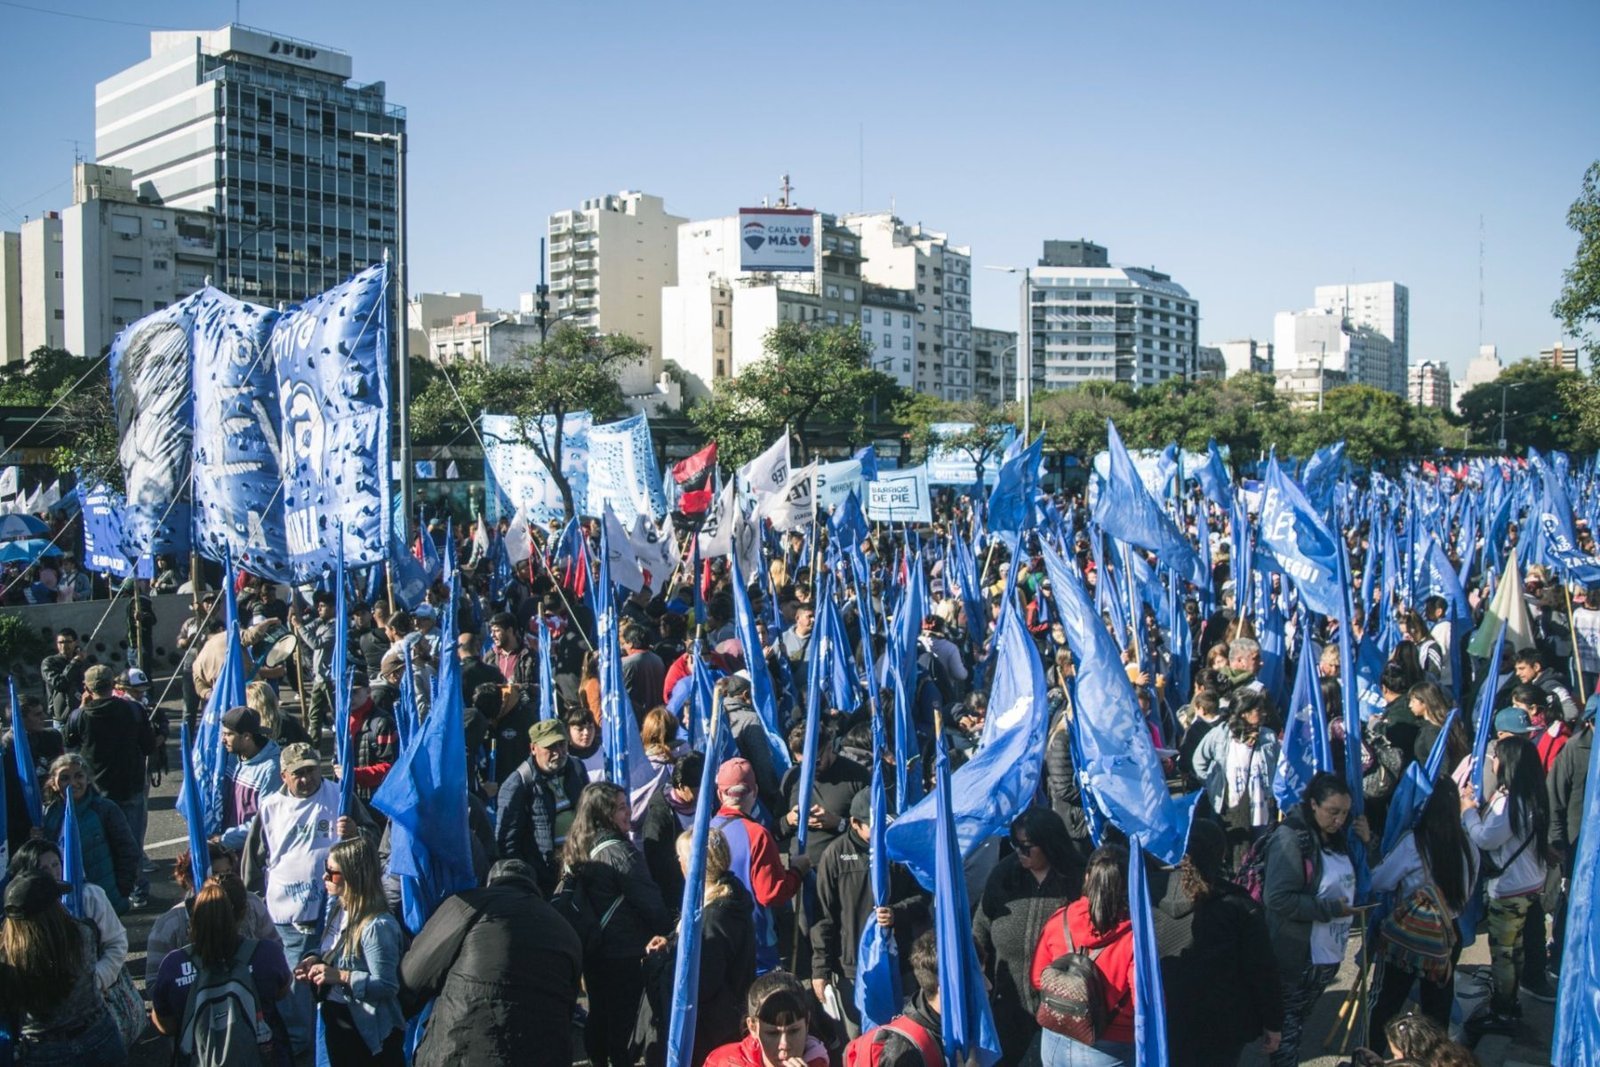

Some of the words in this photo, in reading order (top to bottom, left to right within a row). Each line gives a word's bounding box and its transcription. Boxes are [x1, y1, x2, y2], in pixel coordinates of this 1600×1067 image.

[768, 226, 791, 234] CADA
[768, 233, 798, 246] MÁS
[872, 494, 888, 503] DE
[891, 494, 911, 503] PIE
